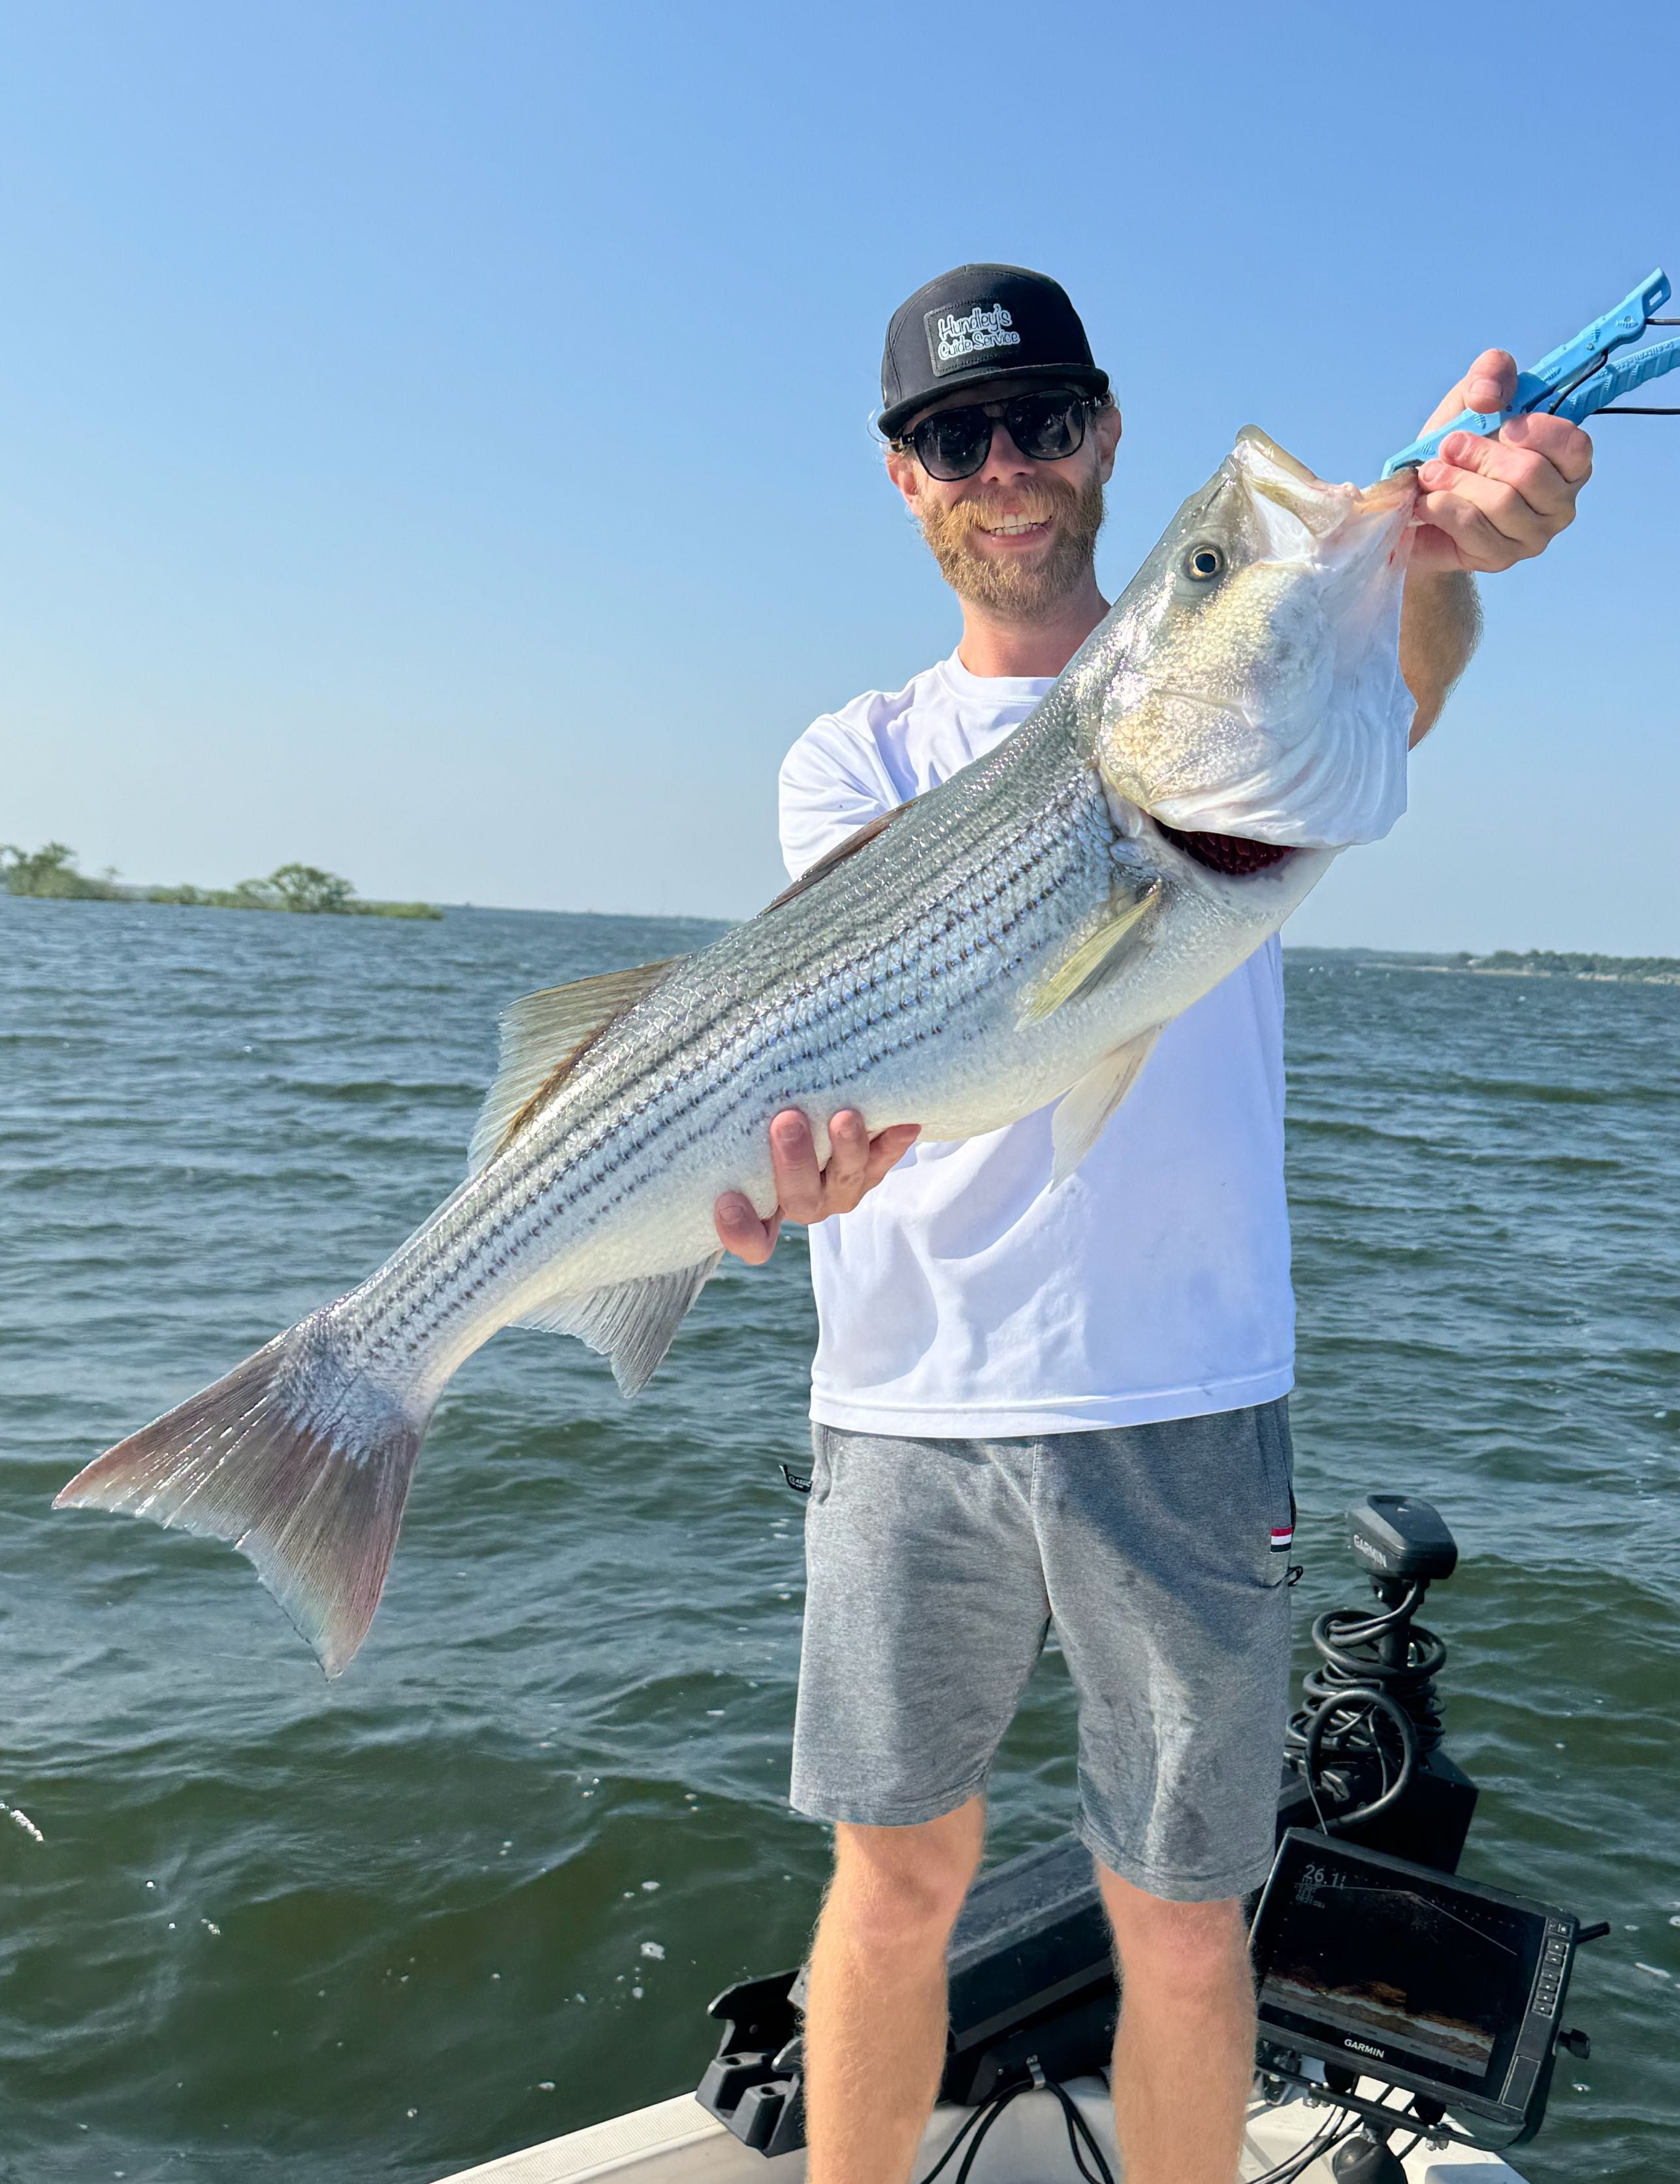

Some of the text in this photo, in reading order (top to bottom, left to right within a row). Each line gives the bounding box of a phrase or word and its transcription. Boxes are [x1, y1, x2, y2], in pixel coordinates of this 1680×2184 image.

[938, 303, 1012, 340] Hundley's
[938, 329, 1020, 360] Guide Service
[1353, 1534, 1387, 1568] GARMIN
[1344, 2038, 1385, 2058] GARMIN
